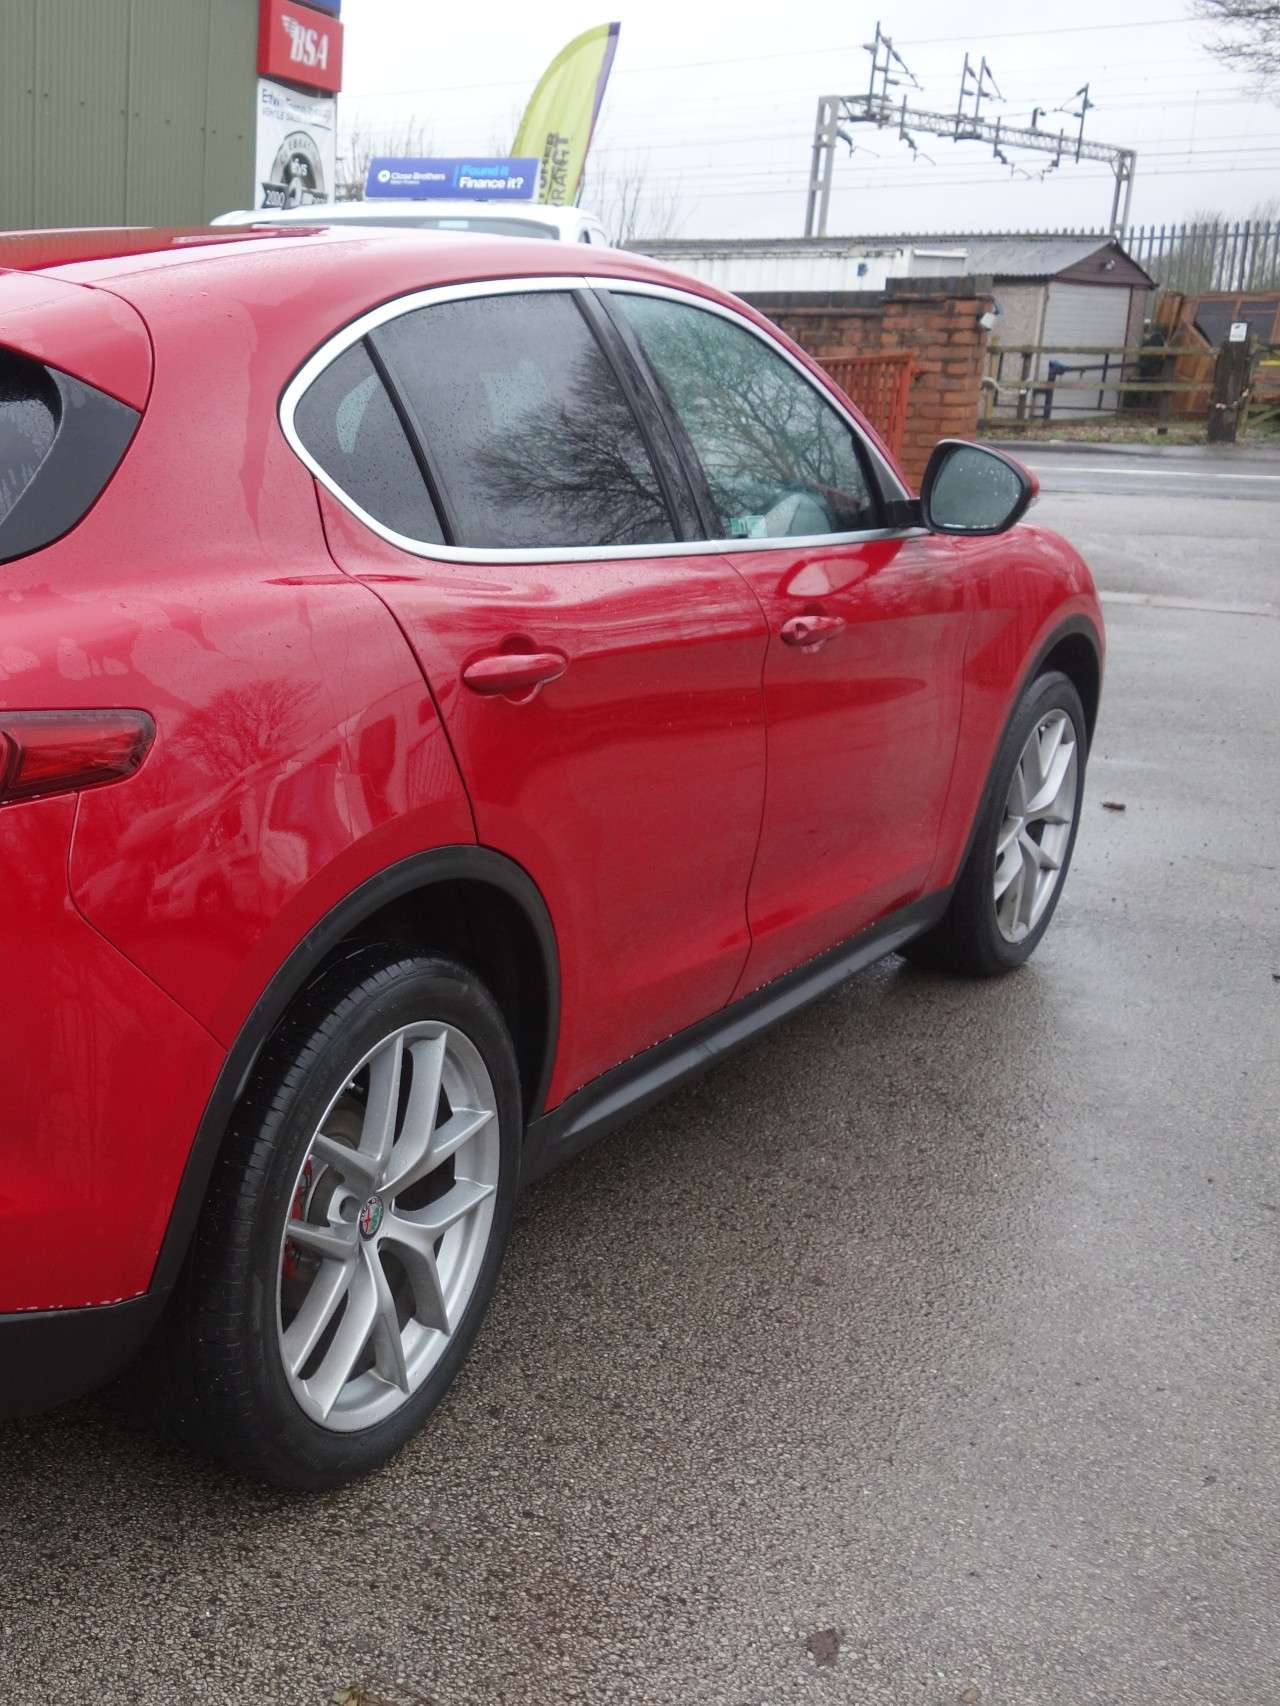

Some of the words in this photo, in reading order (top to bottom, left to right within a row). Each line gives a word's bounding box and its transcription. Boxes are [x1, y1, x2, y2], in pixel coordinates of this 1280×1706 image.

[286, 22, 329, 71] BSA
[459, 177, 506, 189] Finance
[507, 177, 524, 189] it?
